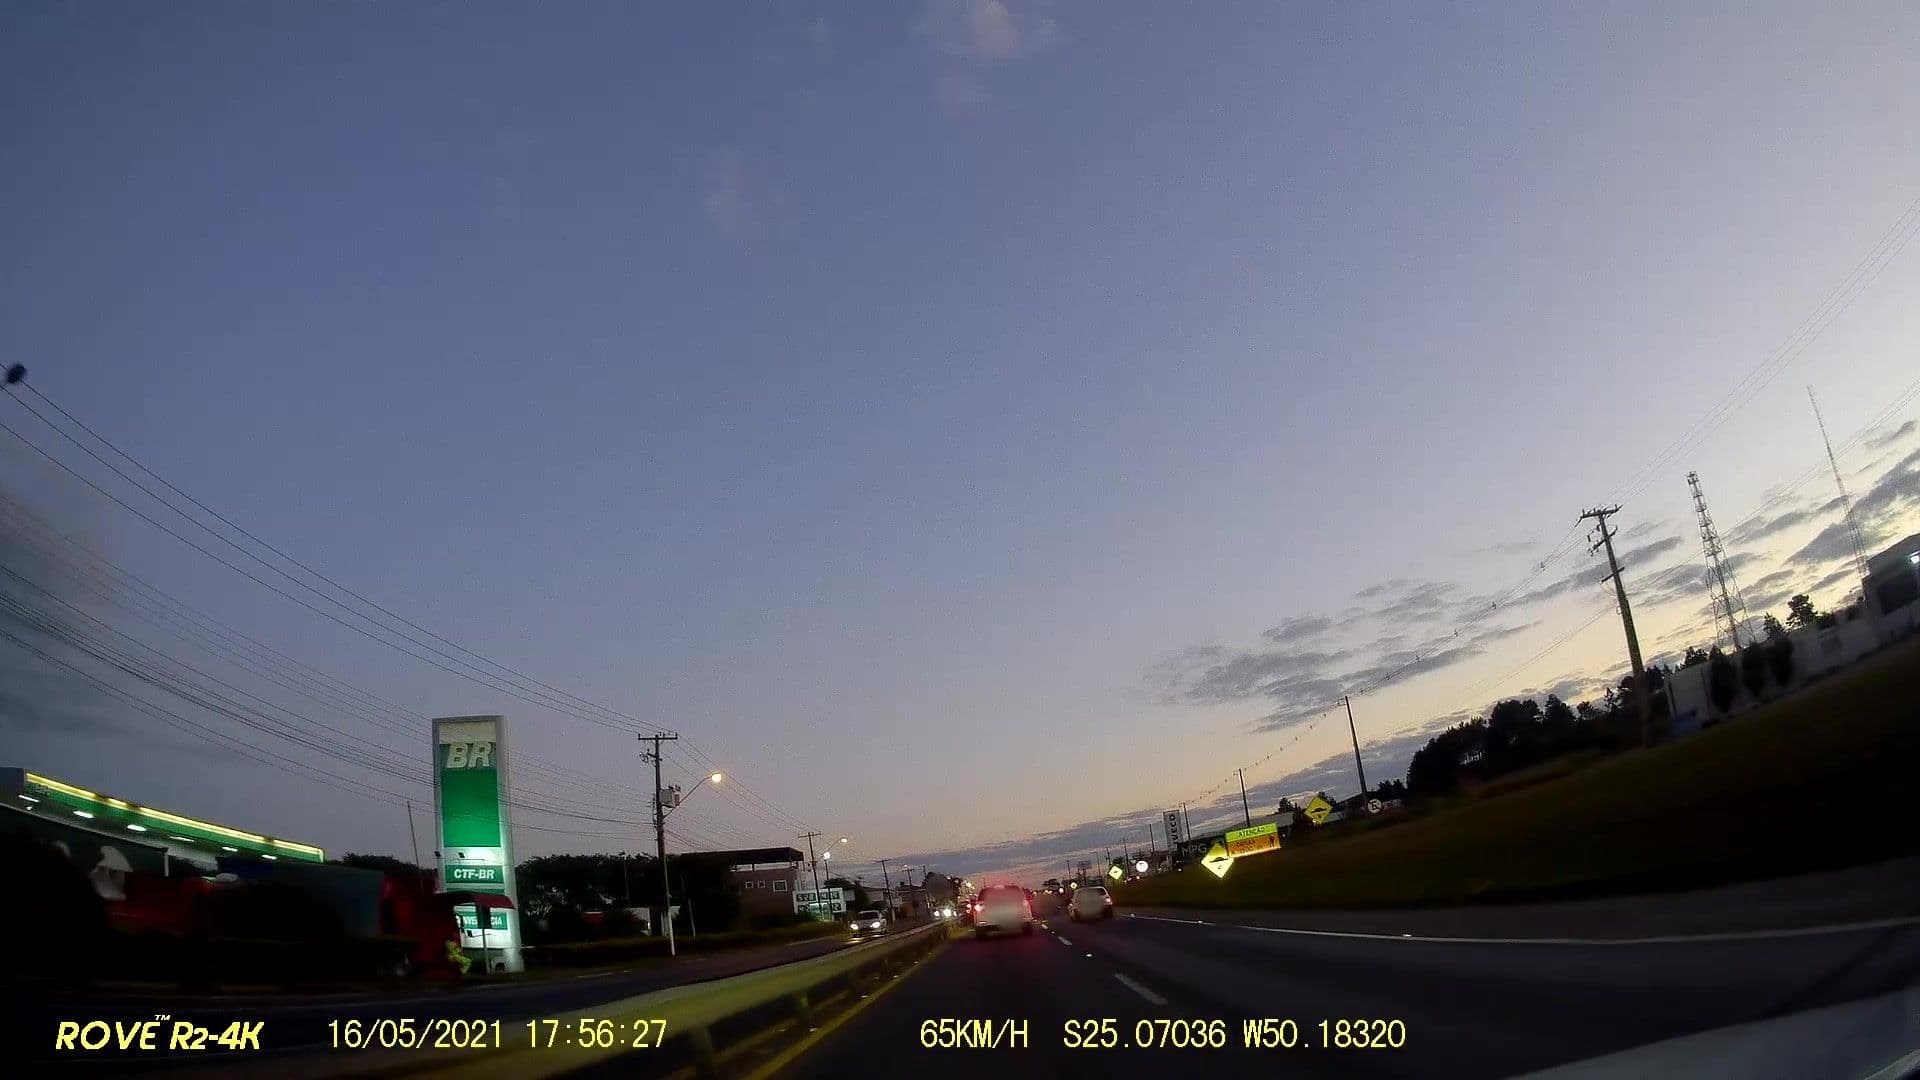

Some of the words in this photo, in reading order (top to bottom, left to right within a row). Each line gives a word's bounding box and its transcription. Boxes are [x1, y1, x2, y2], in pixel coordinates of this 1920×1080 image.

[447, 741, 492, 769] BR
[1238, 826, 1266, 838] ATENÇÃO
[454, 868, 495, 879] CTF-BR
